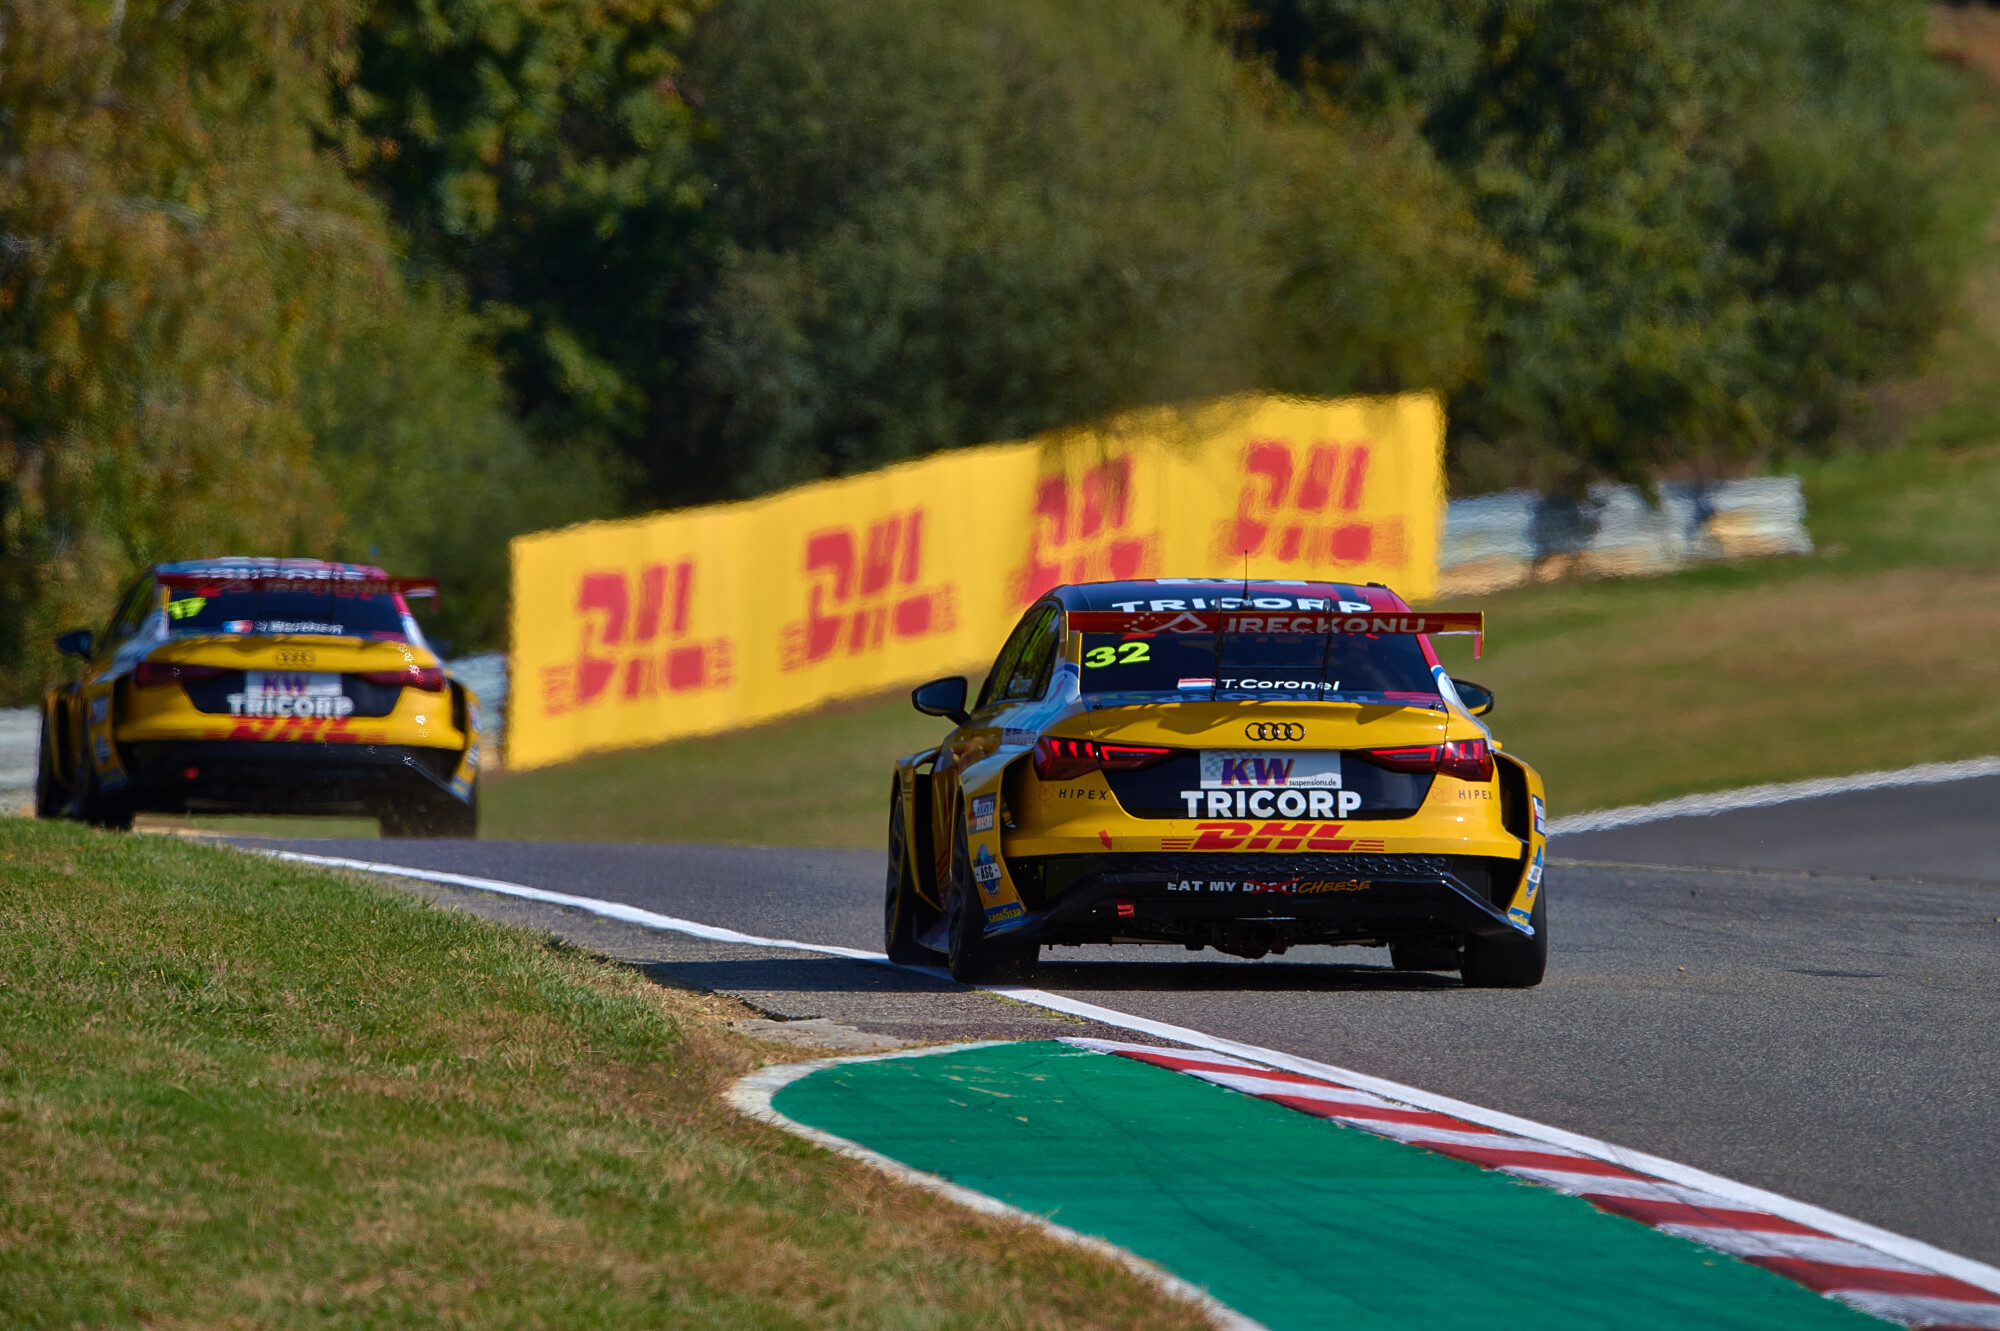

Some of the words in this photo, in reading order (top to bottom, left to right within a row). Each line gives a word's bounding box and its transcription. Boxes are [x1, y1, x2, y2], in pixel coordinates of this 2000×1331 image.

[804, 505, 932, 664] DHL
[1112, 597, 1372, 613] TRICORP
[575, 558, 706, 702] DHL
[1228, 617, 1426, 634] IRECKONU
[1084, 641, 1151, 668] 32
[1221, 678, 1340, 691] T.Coronel
[226, 694, 354, 718] TRICORP
[1221, 758, 1295, 786] KW
[1289, 777, 1337, 788] suspensions.de
[1058, 788, 1107, 800] HIPEX
[1458, 789, 1494, 800] HIPEX
[1180, 790, 1362, 819] TRICORP
[1191, 822, 1355, 850] DHL
[981, 866, 994, 880] ASC
[1167, 880, 1204, 891] EAT
[1209, 881, 1237, 892] MY
[1298, 878, 1371, 895] CHEESE
